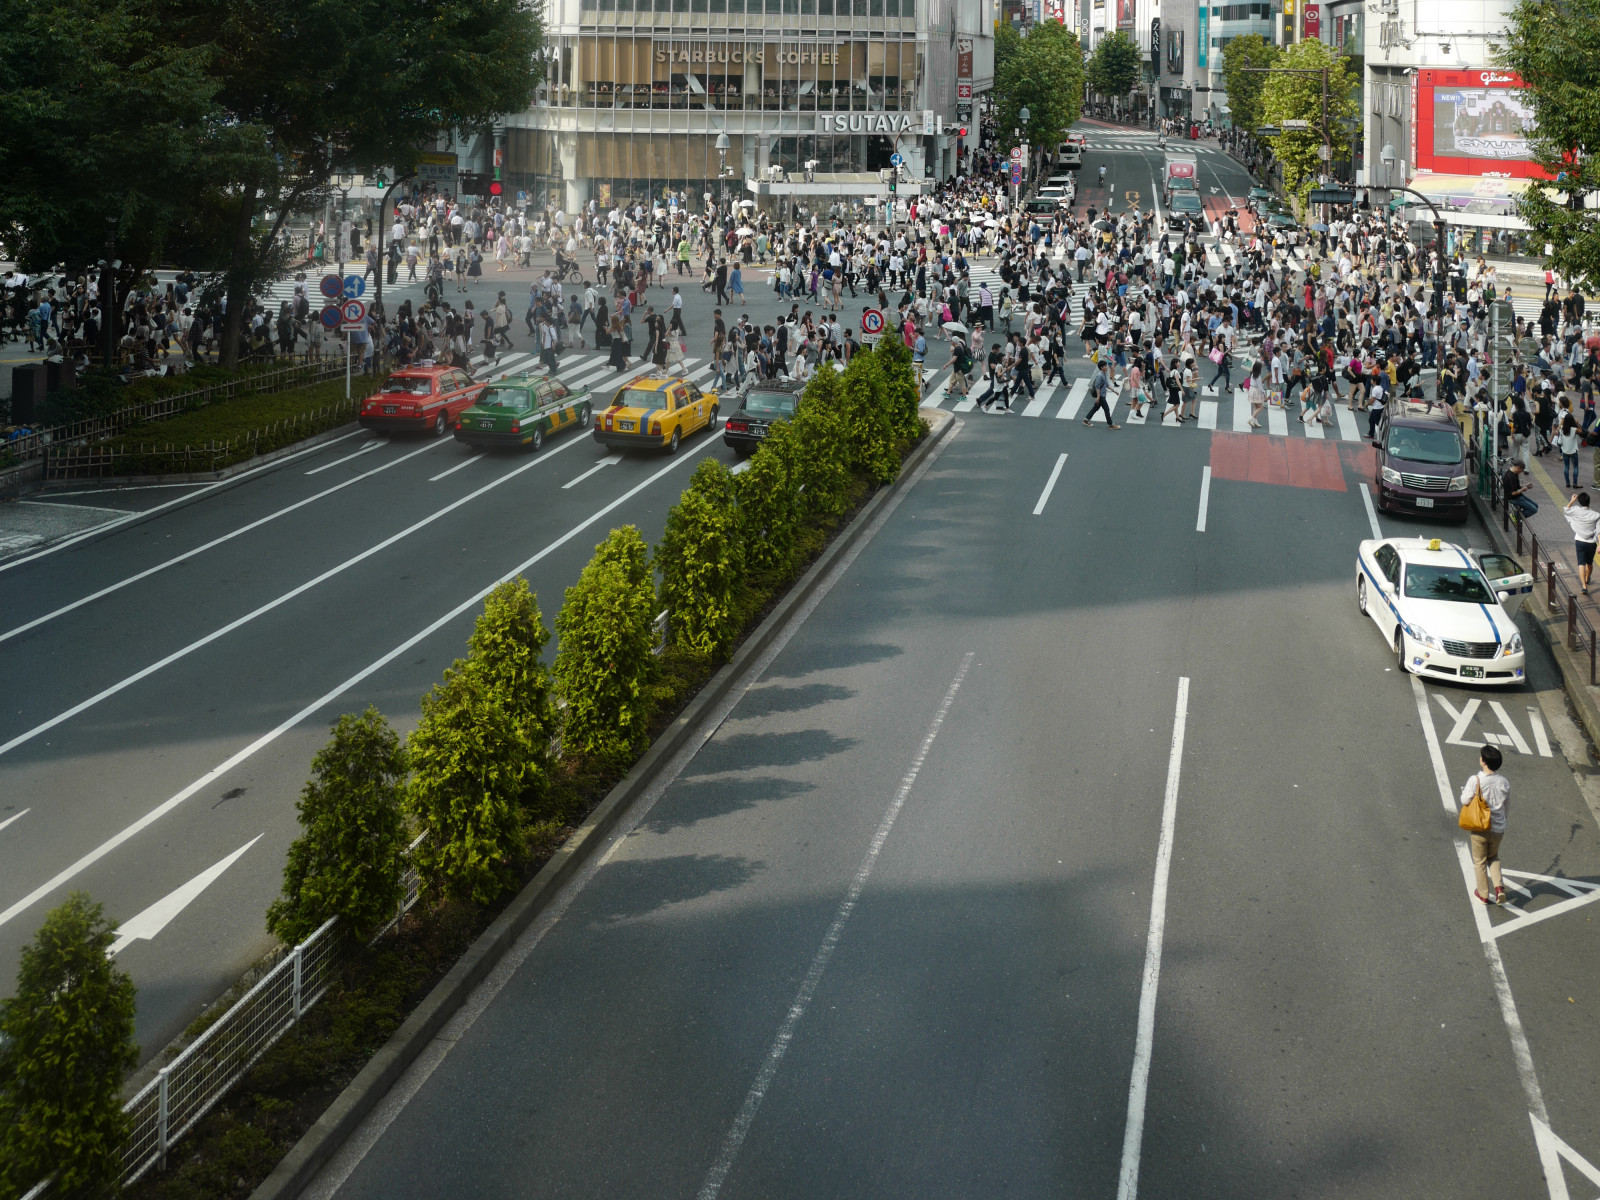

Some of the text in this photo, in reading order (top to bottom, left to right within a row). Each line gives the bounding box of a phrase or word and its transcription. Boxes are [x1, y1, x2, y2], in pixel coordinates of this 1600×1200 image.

[1152, 22, 1160, 52] ZARA
[656, 49, 839, 65] STARBUCKS COFFEE
[1480, 72, 1514, 86] Glico
[960, 87, 970, 97] 本
[820, 114, 913, 133] TSUTAYA
